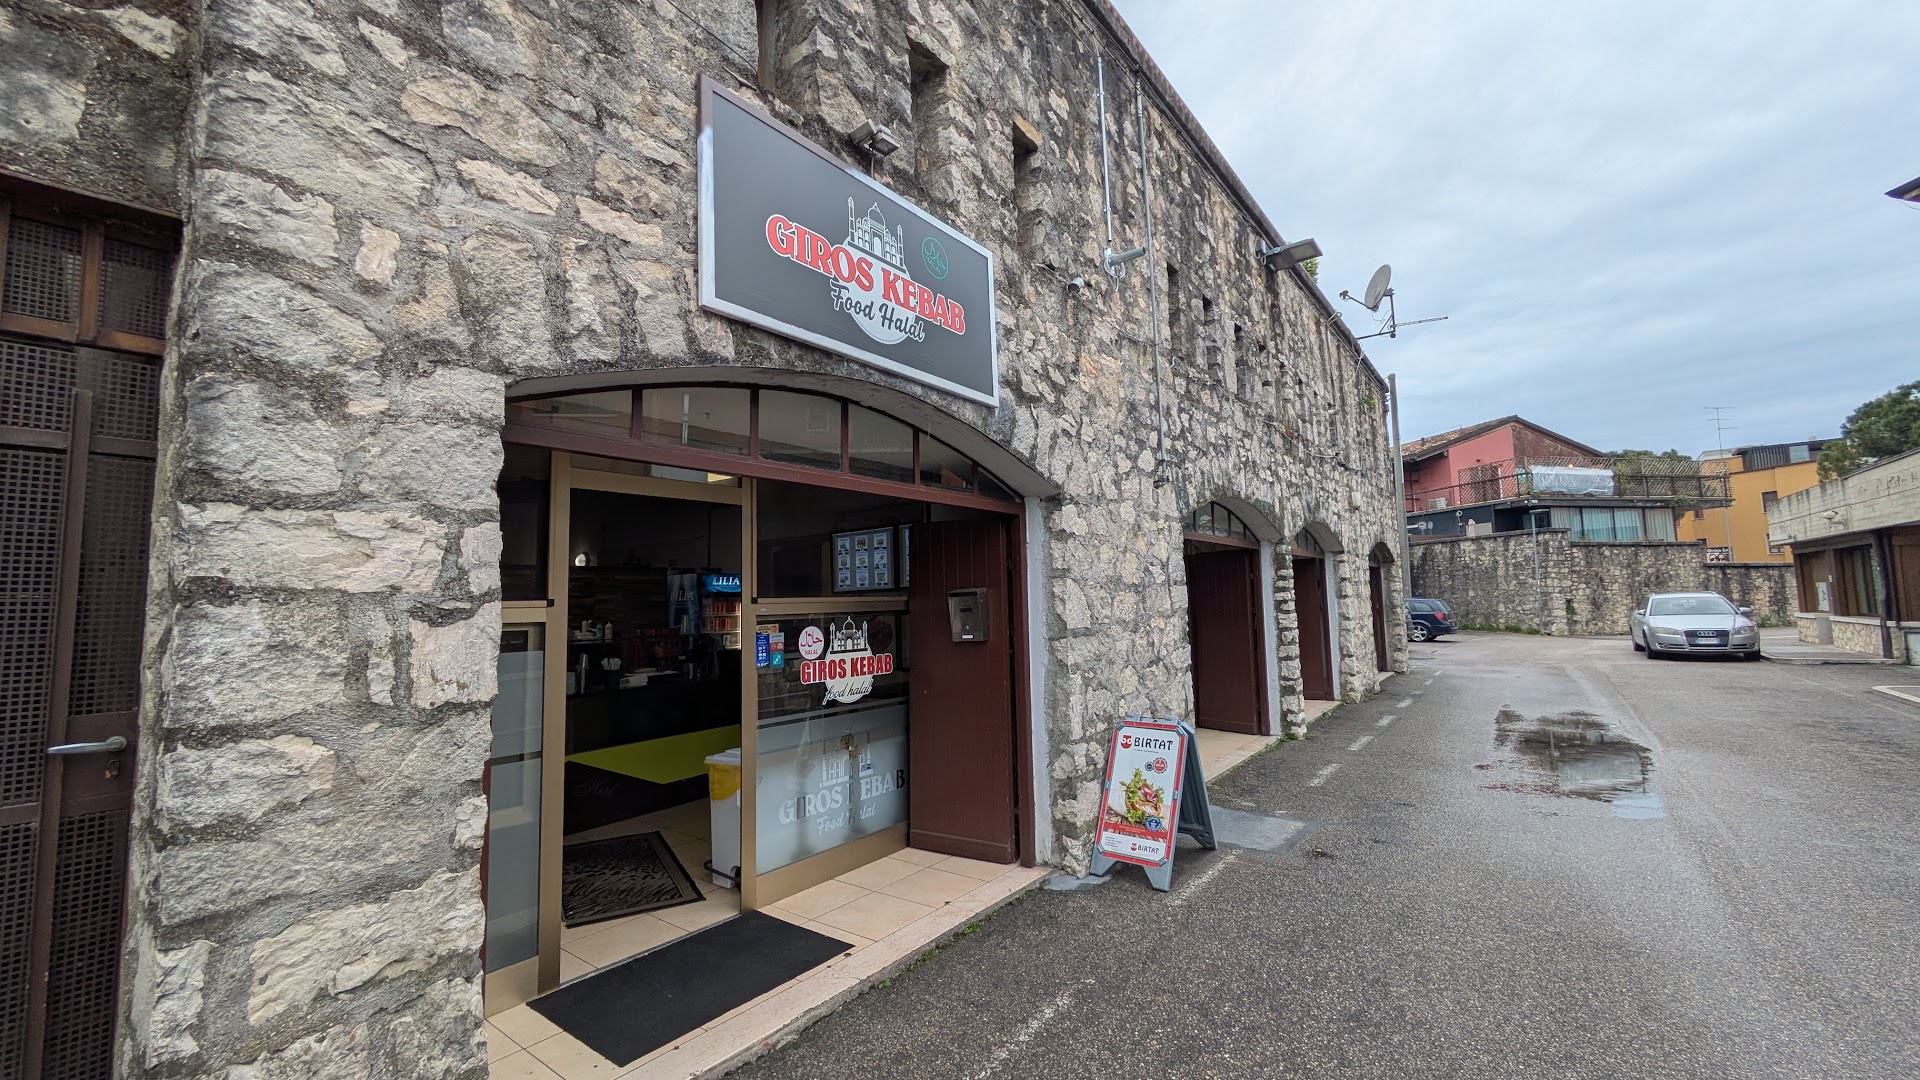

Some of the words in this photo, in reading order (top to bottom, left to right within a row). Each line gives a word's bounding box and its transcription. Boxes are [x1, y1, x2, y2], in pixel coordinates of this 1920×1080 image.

[766, 214, 874, 292] GIROS
[881, 267, 966, 335] KEBAB
[925, 255, 942, 276] HALAL
[830, 279, 875, 320] Food
[878, 302, 924, 342] Halal
[711, 576, 740, 586] LILIA
[800, 630, 823, 648] حلال
[804, 648, 819, 656] HALAL
[801, 658, 847, 684] GIROS
[850, 653, 893, 677] KEBAB
[822, 682, 849, 705] food
[846, 678, 874, 697] halal
[1133, 736, 1174, 751] BIRTAT
[816, 812, 845, 836] Food
[1137, 844, 1160, 855] BIRTAT
